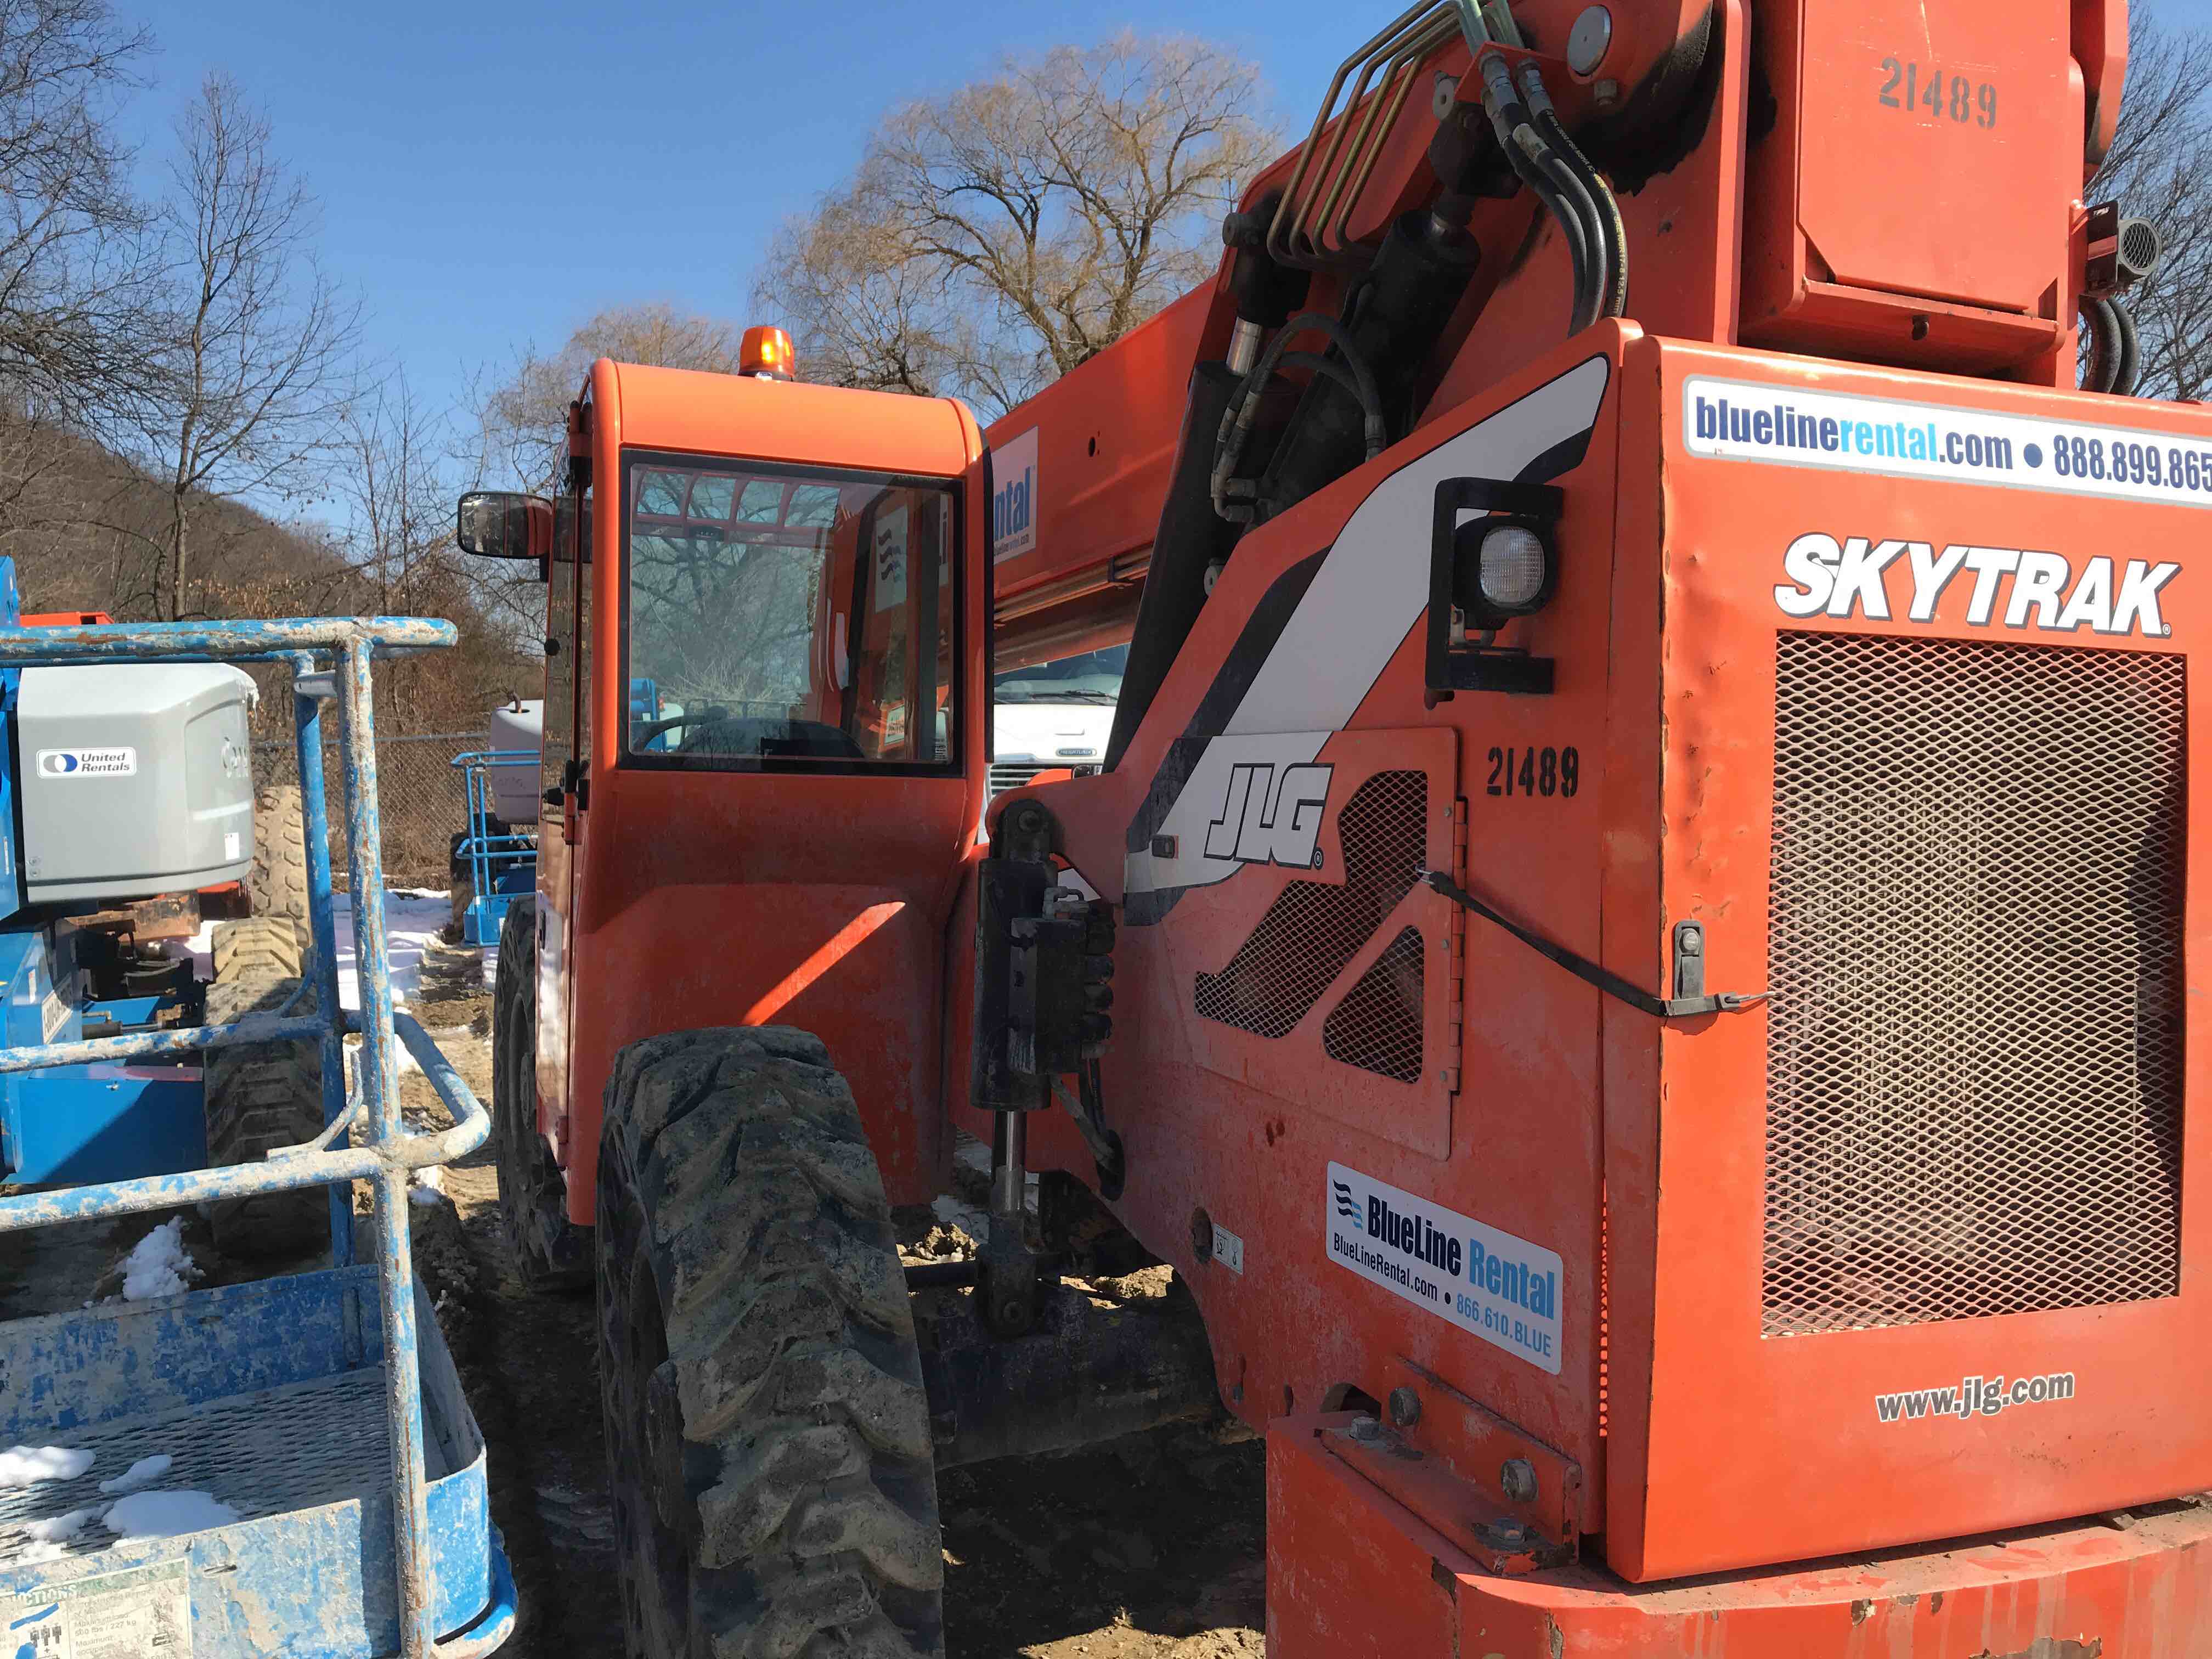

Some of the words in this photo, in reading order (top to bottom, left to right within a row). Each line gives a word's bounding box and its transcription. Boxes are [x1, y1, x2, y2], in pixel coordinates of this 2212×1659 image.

[1878, 57, 1997, 129] 21489
[1696, 396, 2013, 469] bluelinerental.com
[1774, 531, 2183, 637] SKYTRAK
[81, 753, 126, 762] United
[82, 763, 130, 772] Rentals
[1487, 746, 1578, 798] 21489
[1368, 1194, 1462, 1277] BlueLine
[1469, 1238, 1555, 1321] Rental
[1333, 1232, 1438, 1302] BlueLineRental.com
[1457, 1293, 1551, 1357] 866.610.BLUE
[1876, 1372, 2075, 1422] www.jlg.com
